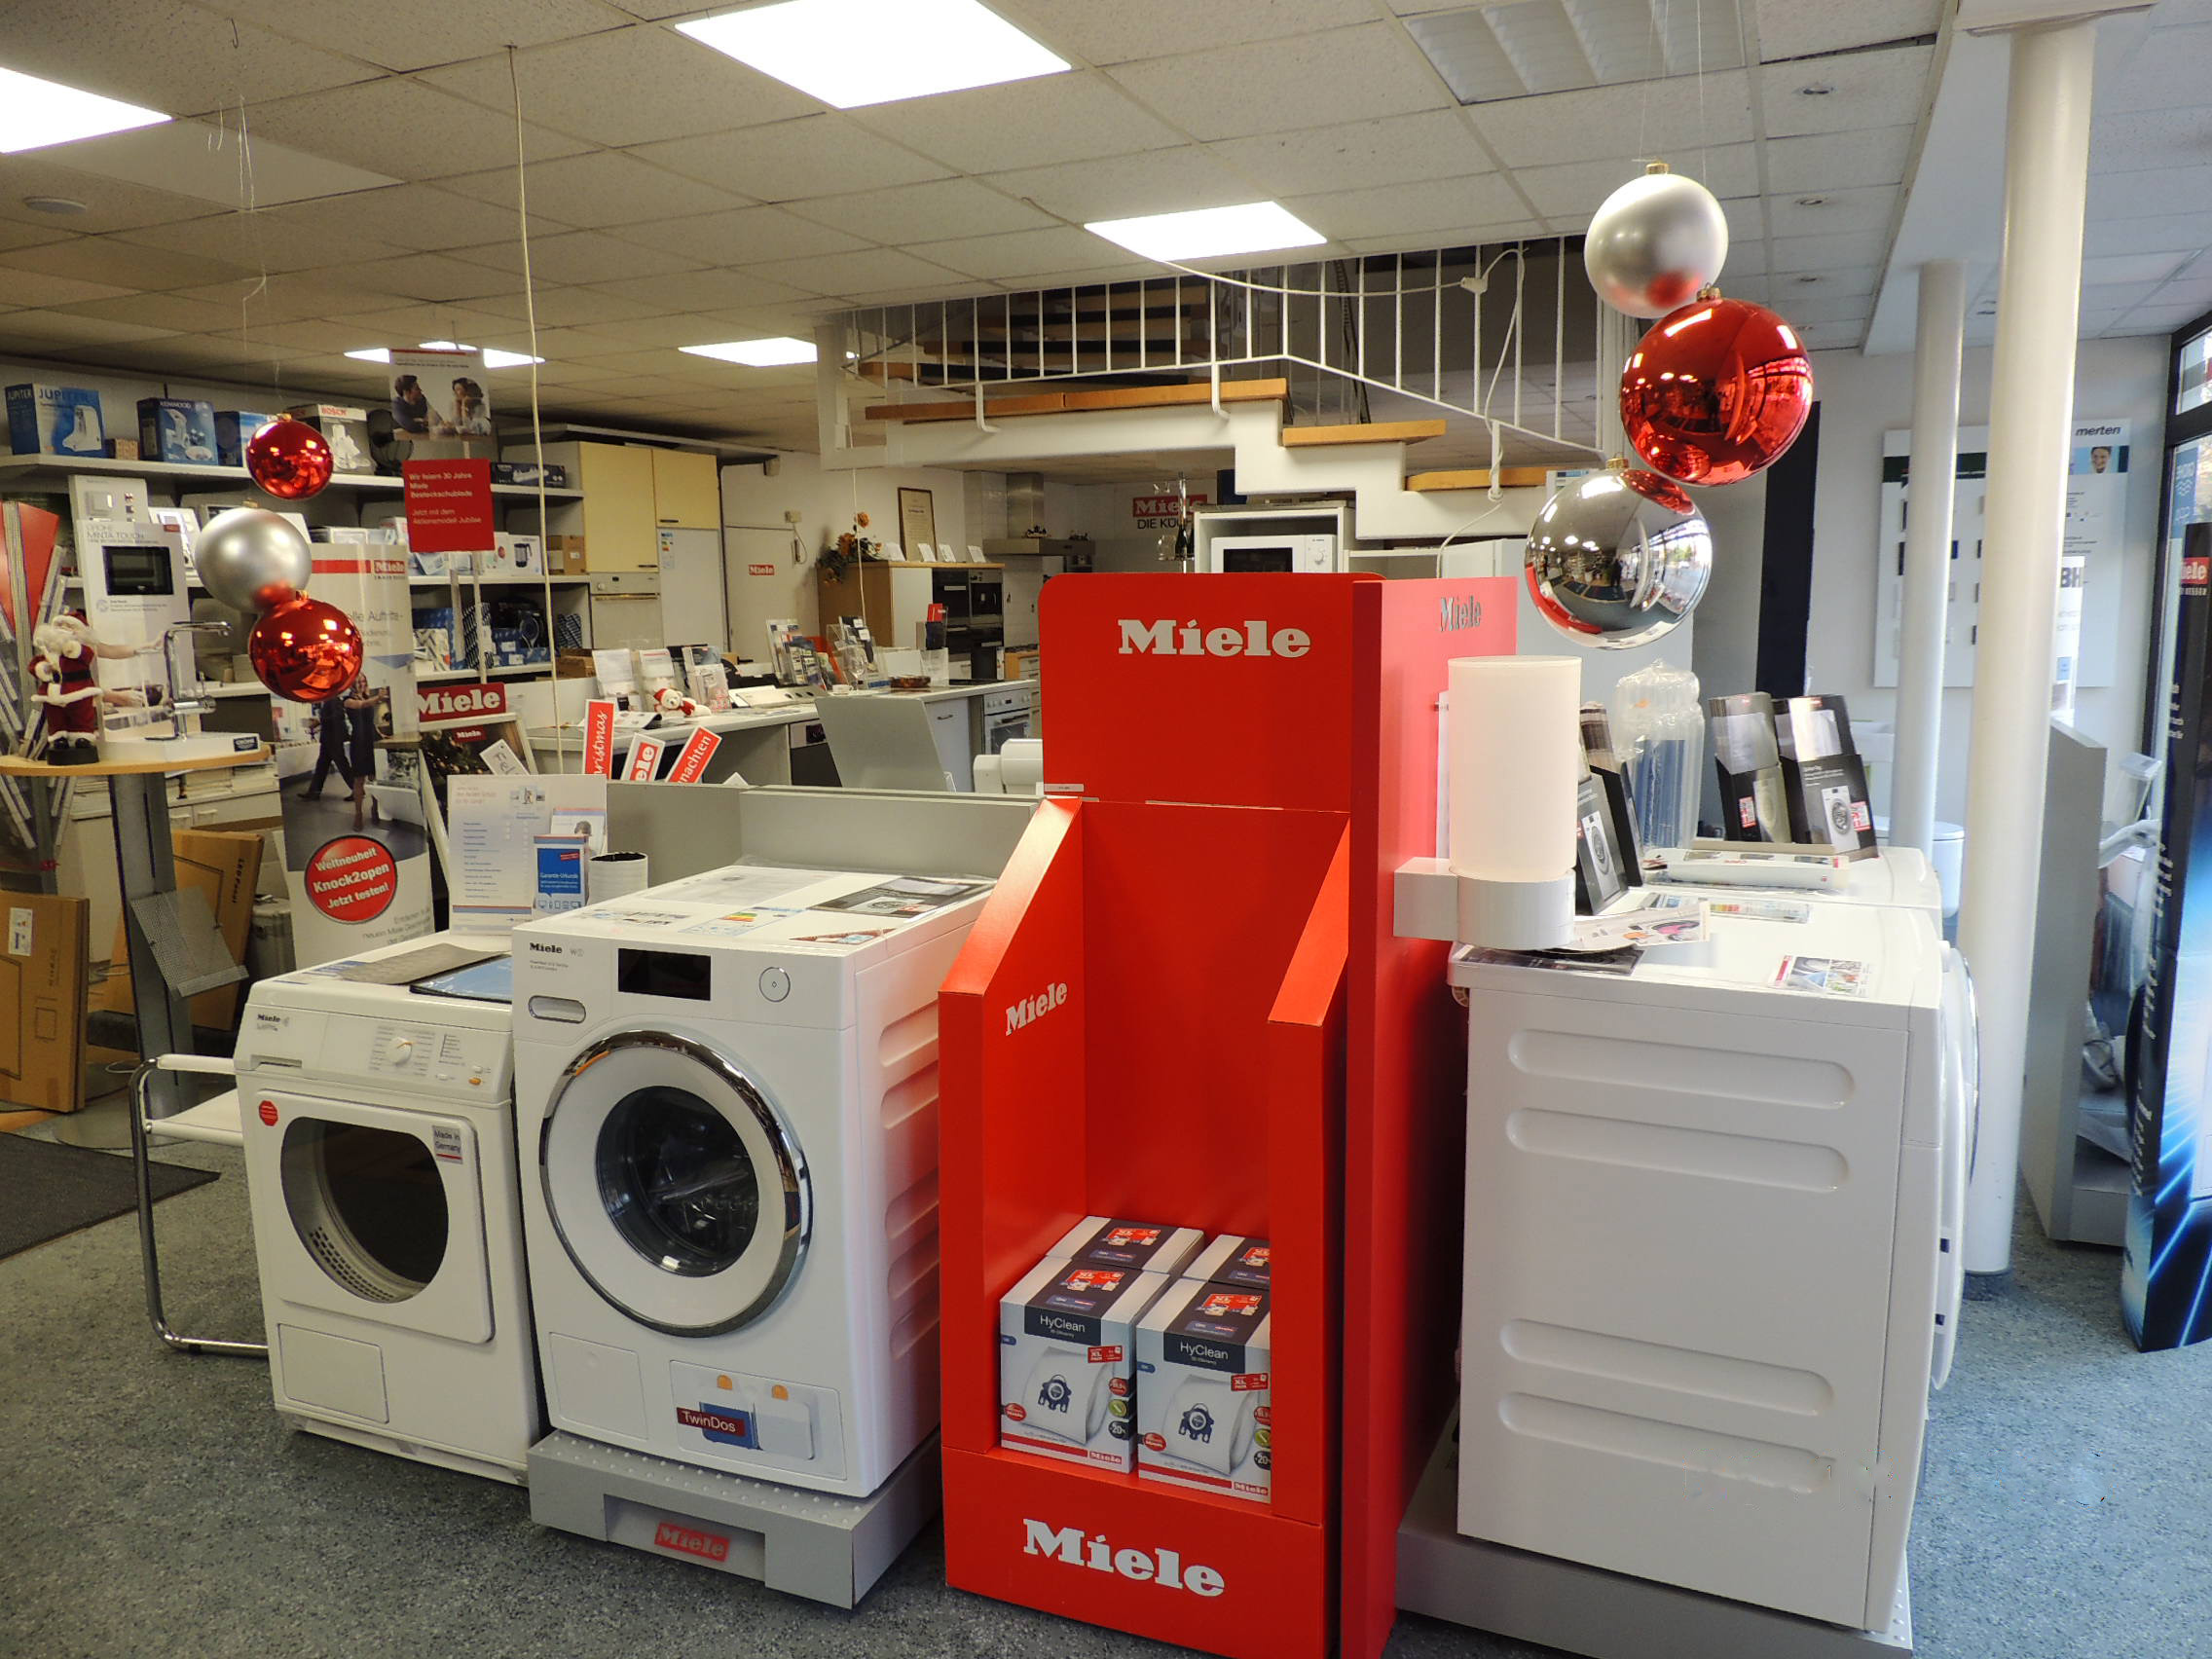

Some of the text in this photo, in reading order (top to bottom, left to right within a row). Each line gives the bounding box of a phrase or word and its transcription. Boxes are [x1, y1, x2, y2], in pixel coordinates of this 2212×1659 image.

[2076, 425, 2121, 436] merten
[1137, 518, 1158, 529] DIE
[1440, 595, 1482, 632] Miele
[1118, 618, 1311, 658] Miele
[417, 688, 500, 715] Miele
[634, 746, 655, 781] ele
[315, 847, 378, 871] Weltneuheit
[313, 864, 389, 894] Knock2open
[327, 882, 389, 908] Jetzt testen!
[530, 941, 563, 954] Miele
[257, 1014, 281, 1023] Miele
[1005, 982, 1068, 1037] Miele
[434, 1140, 461, 1154] Germany
[1040, 1314, 1086, 1333] HyClean
[1180, 1341, 1229, 1361] HyClean
[682, 1411, 737, 1433] TwinDos
[1090, 1452, 1123, 1463] Miele
[1235, 1482, 1268, 1494] Miele
[658, 1525, 726, 1557] Miele
[1023, 1518, 1225, 1597] Miele
